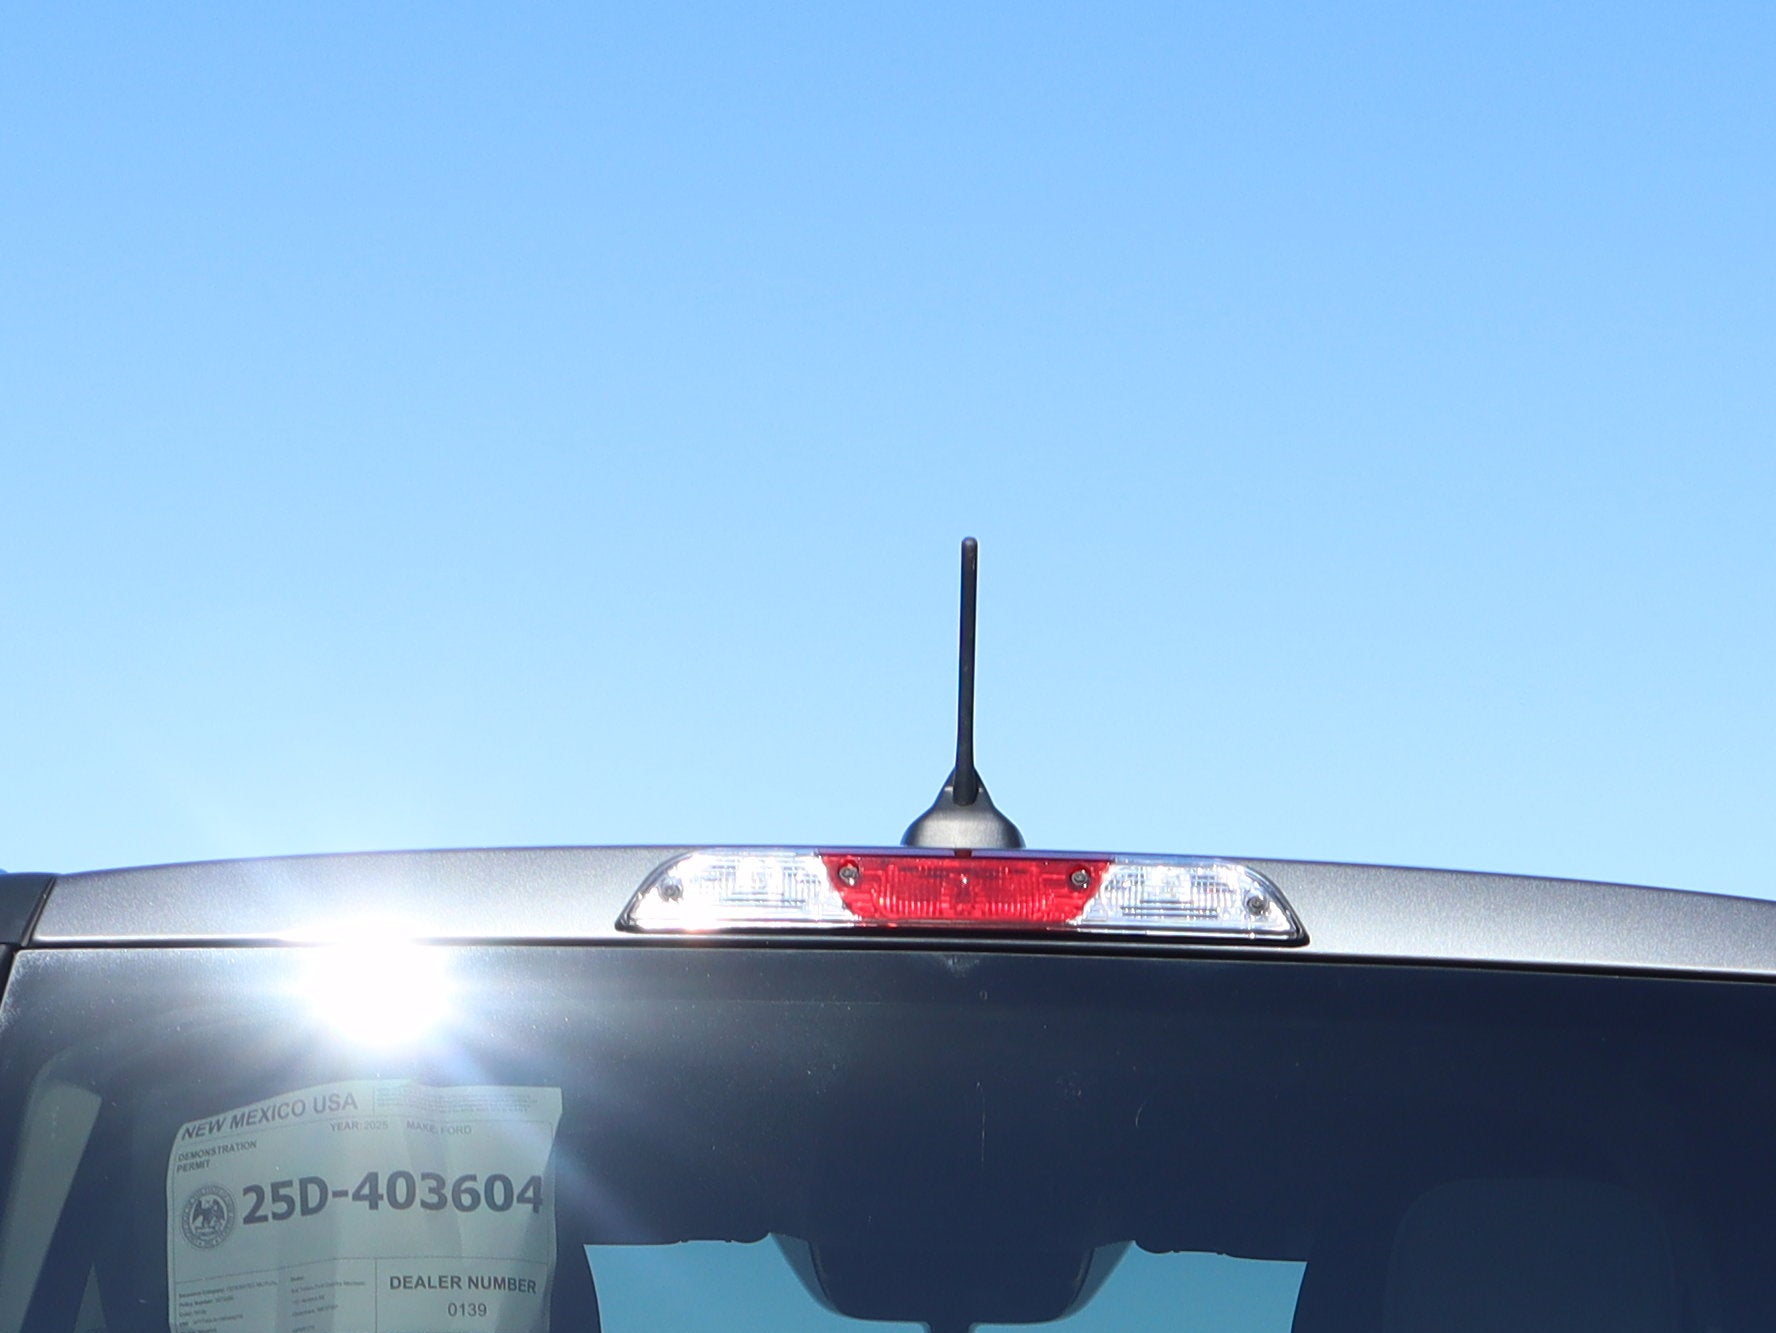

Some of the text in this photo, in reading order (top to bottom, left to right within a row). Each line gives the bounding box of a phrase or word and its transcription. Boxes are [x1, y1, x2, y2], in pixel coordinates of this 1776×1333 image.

[181, 1118, 225, 1141] NEW
[229, 1100, 306, 1130] MEXICO
[313, 1092, 358, 1114] USA
[364, 1120, 389, 1131] 2025
[441, 1125, 472, 1135] FORD
[178, 1140, 258, 1162] DEMONSTRATION
[176, 1159, 211, 1173] PERMIT
[242, 1170, 543, 1225] 25D-403604
[389, 1275, 537, 1294] DEALER NUMBER
[447, 1302, 487, 1317] 0139
